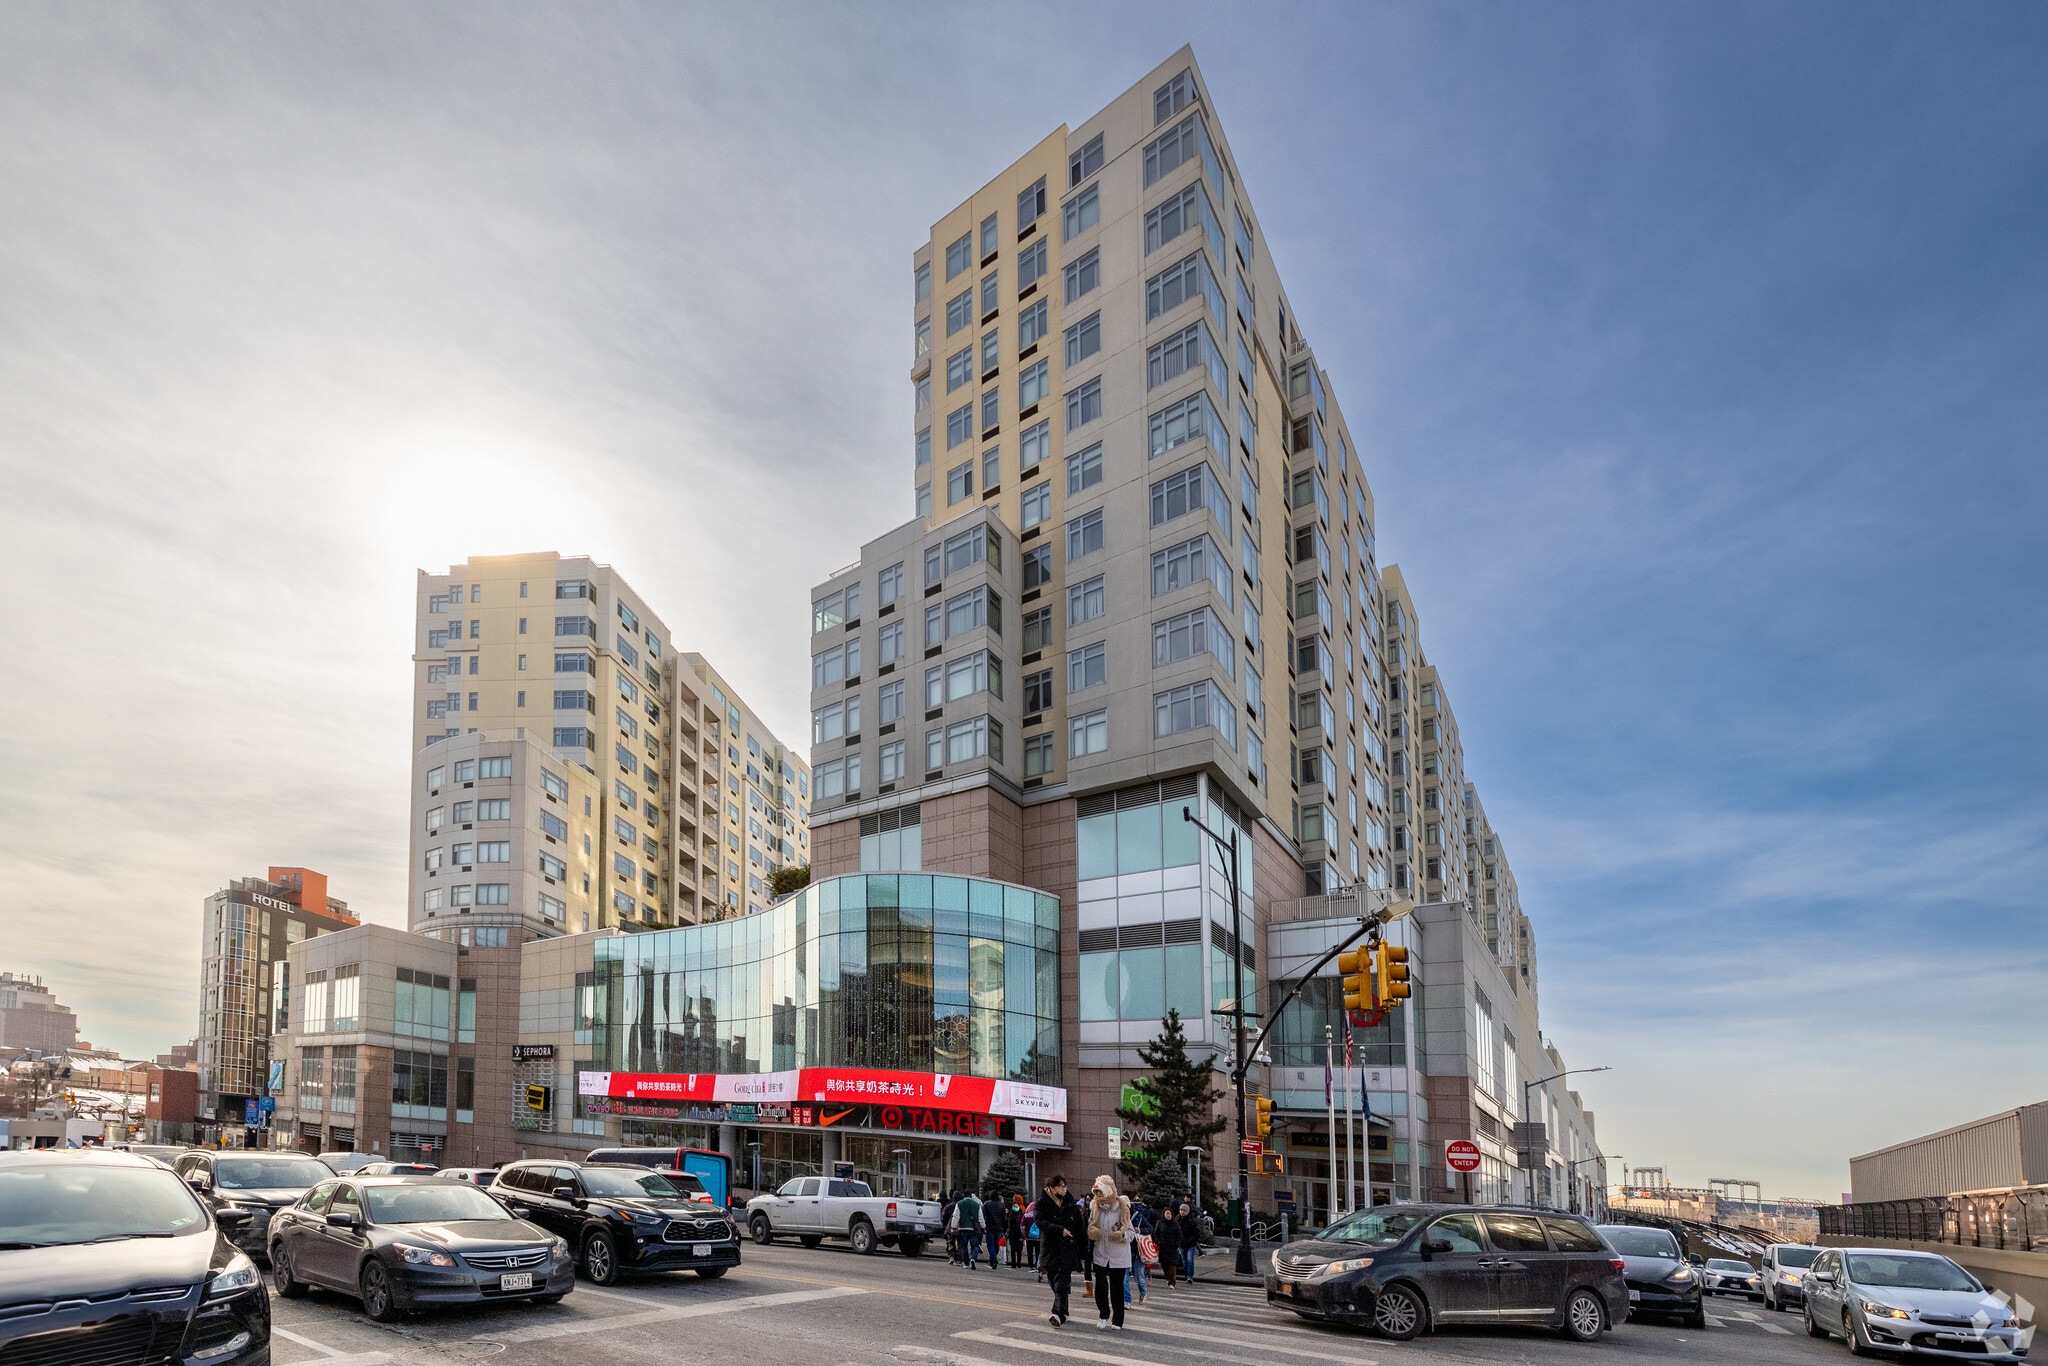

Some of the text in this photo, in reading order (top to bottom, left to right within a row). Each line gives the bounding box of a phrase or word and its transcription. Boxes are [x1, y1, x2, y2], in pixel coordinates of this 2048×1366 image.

[252, 893, 294, 914] HOTEL
[523, 1047, 552, 1056] SEPHORA
[1015, 1098, 1050, 1108] SKYVIEW
[758, 1103, 787, 1121] Burlington
[907, 1109, 1006, 1137] TARGET
[1037, 1126, 1052, 1135] CVS
[1030, 1133, 1052, 1141] pharmacy
